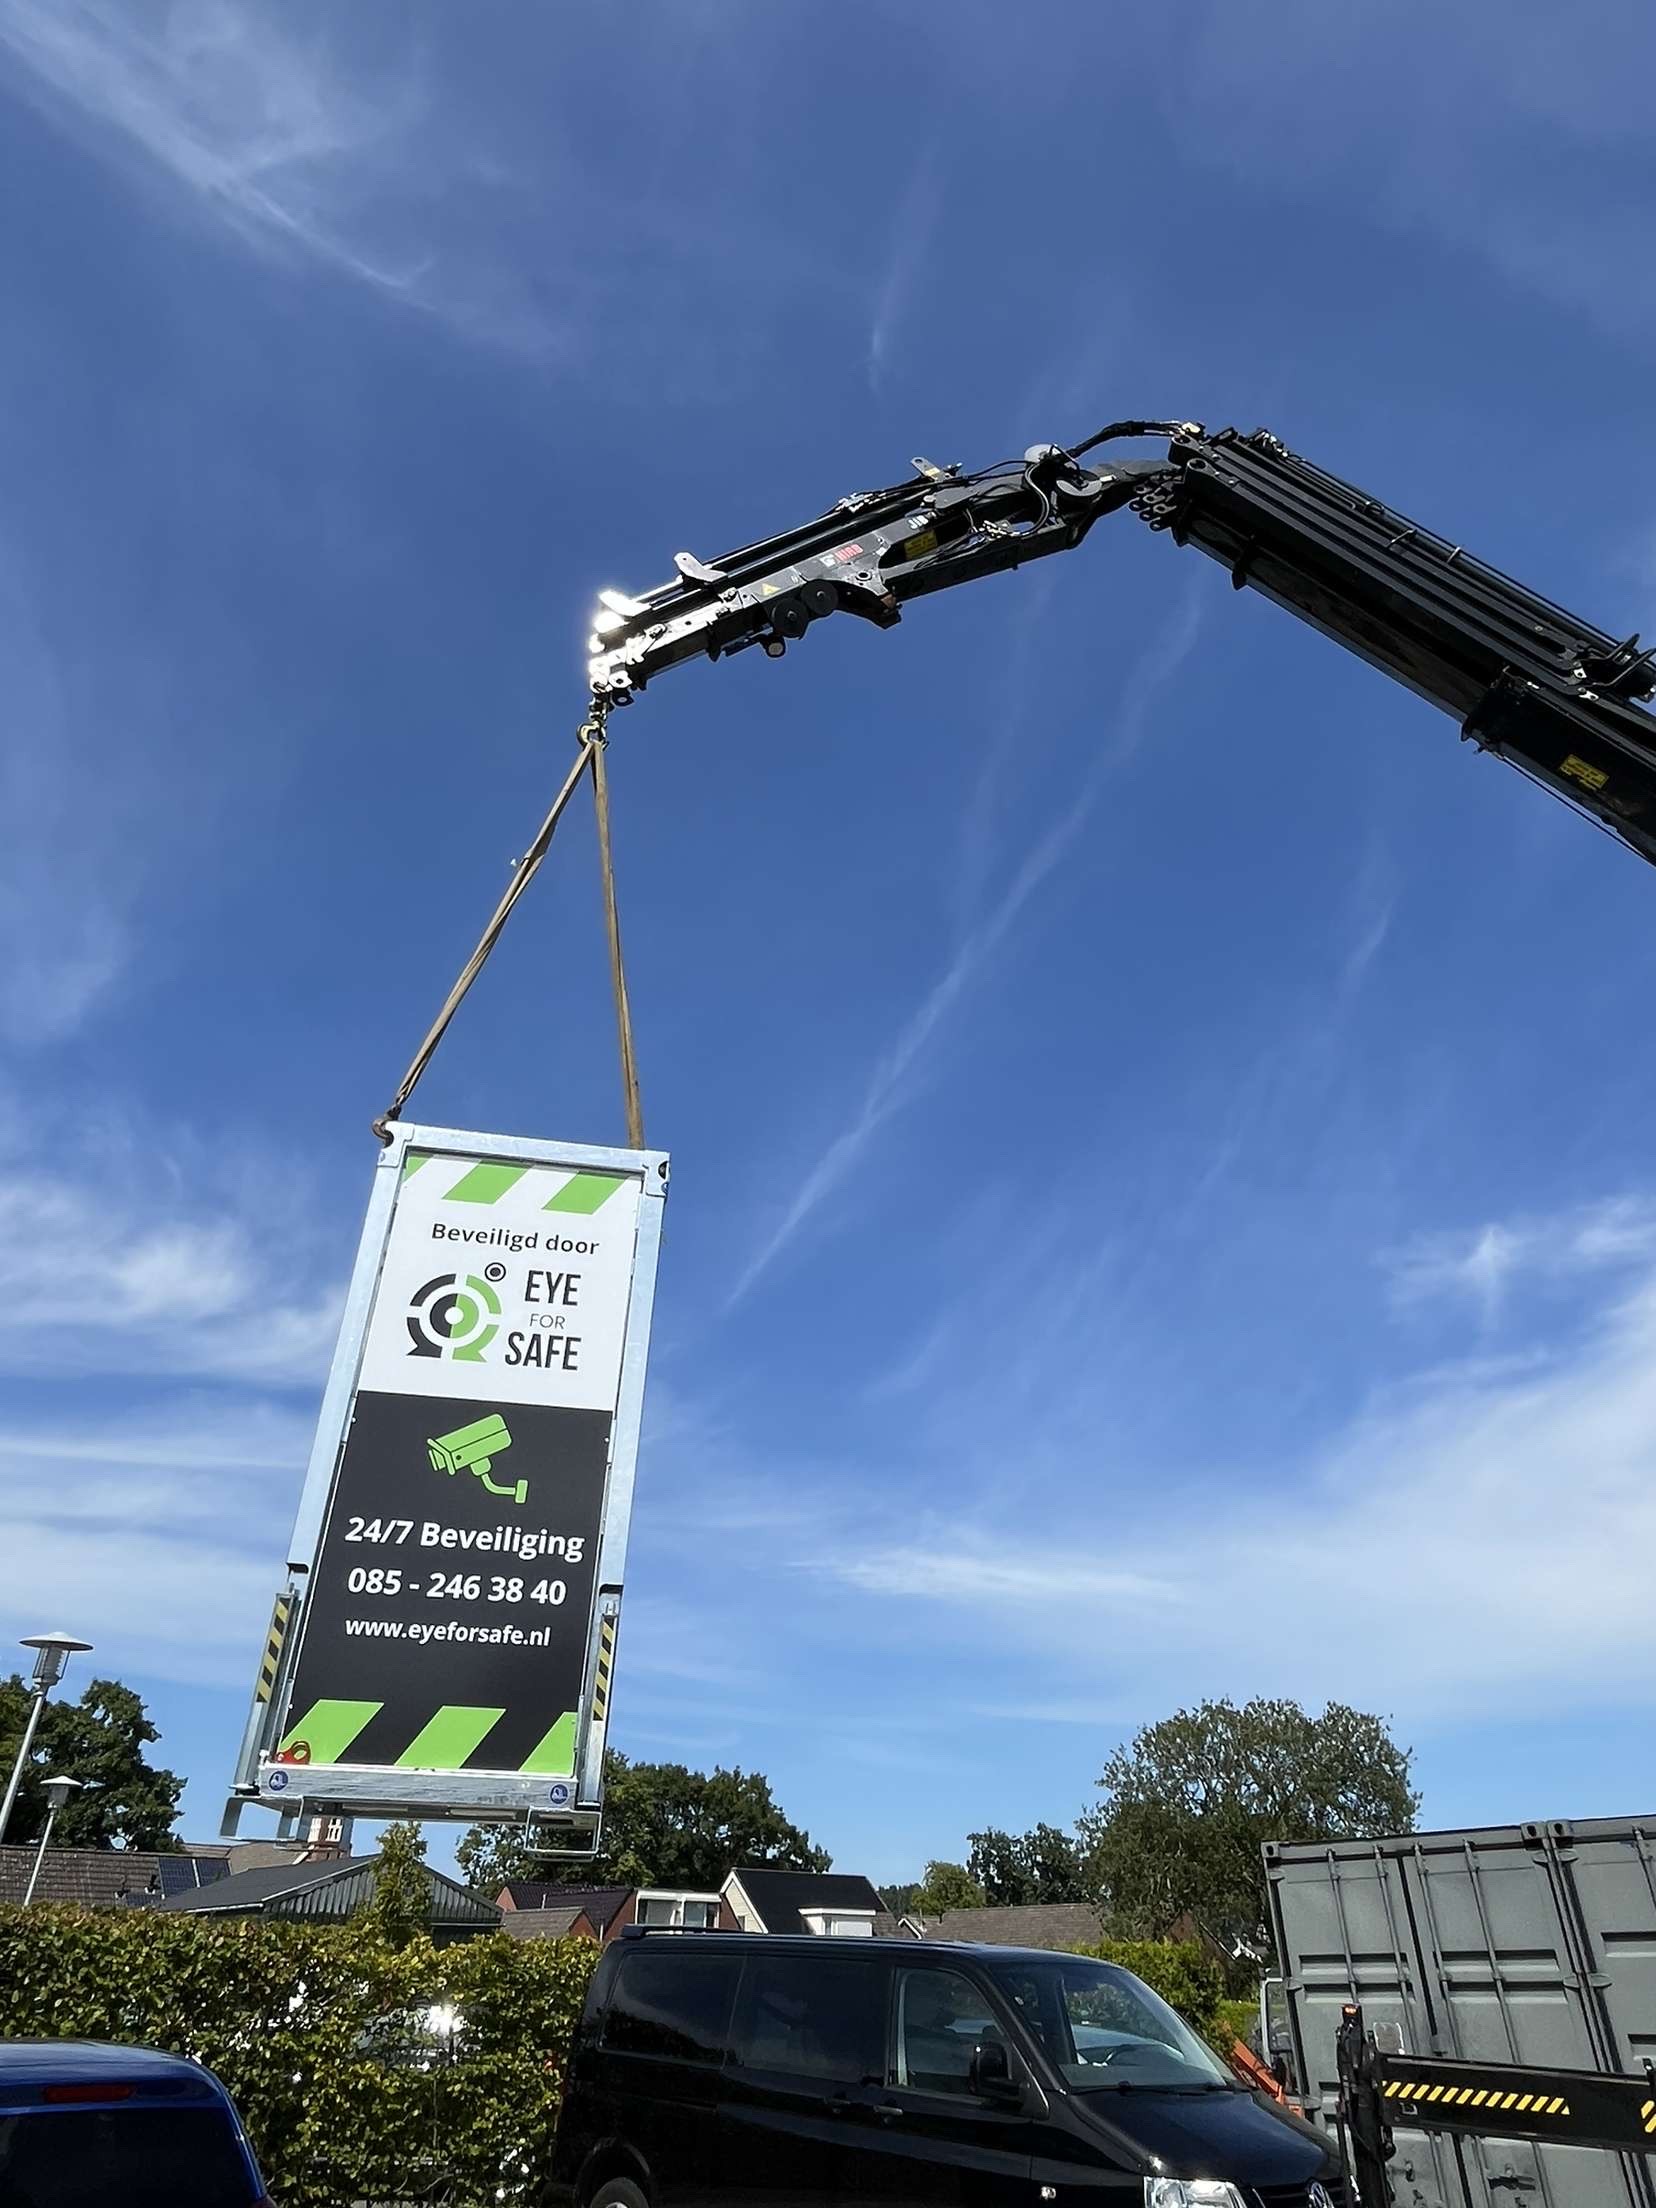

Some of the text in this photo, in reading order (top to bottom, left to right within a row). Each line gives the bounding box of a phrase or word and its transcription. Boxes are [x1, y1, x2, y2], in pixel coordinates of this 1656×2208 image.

[431, 1223, 600, 1255] Beveiligd door
[524, 1269, 582, 1306] EYE
[529, 1313, 566, 1330] FOR
[504, 1331, 582, 1371] SAFE
[344, 1516, 586, 1563] 24/7 Beveiliging
[347, 1567, 403, 1596] 085
[425, 1572, 482, 1601] 246
[487, 1575, 525, 1603] 38
[529, 1578, 568, 1606] 40
[344, 1618, 551, 1647] www.eyeforsafe.nl
